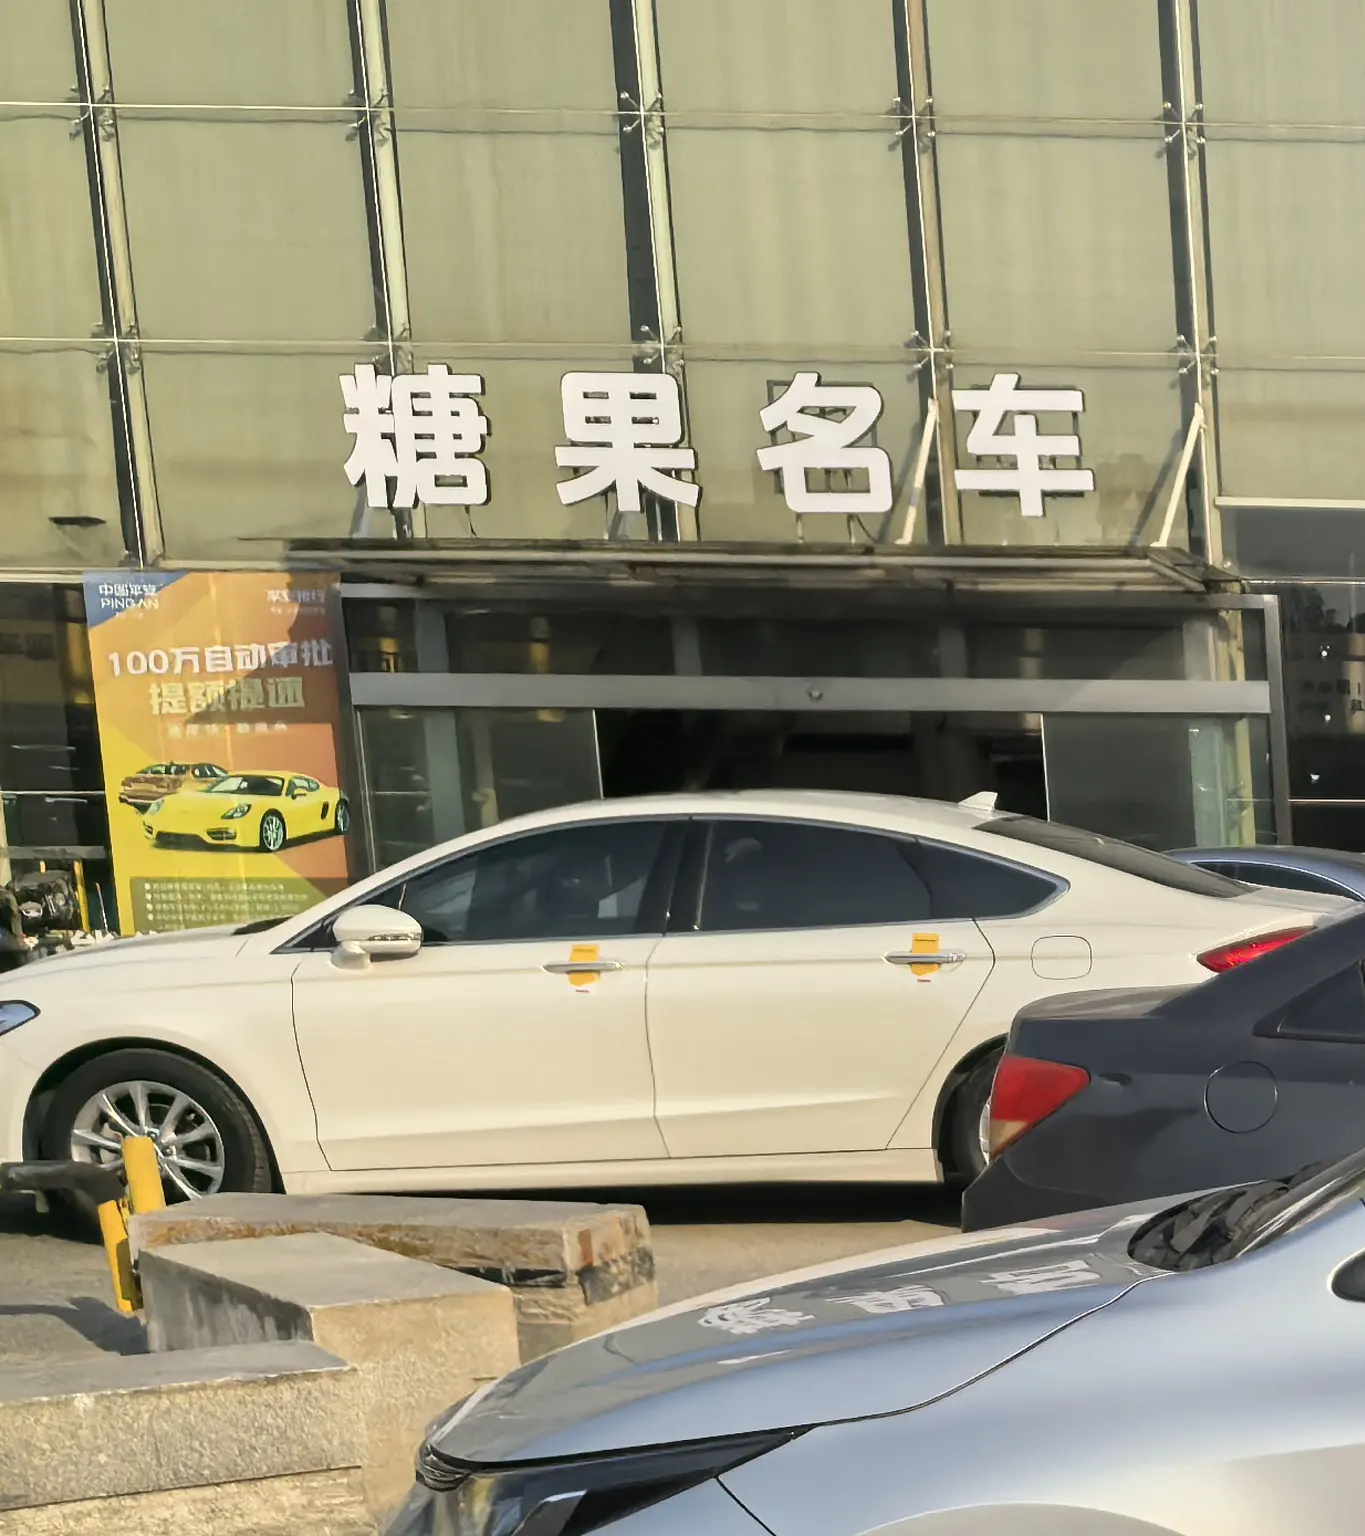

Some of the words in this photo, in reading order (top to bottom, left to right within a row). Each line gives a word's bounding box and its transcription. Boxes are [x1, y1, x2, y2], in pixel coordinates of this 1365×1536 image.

[338, 363, 1096, 518] 糖果名车
[107, 637, 334, 678] 100万自动审批
